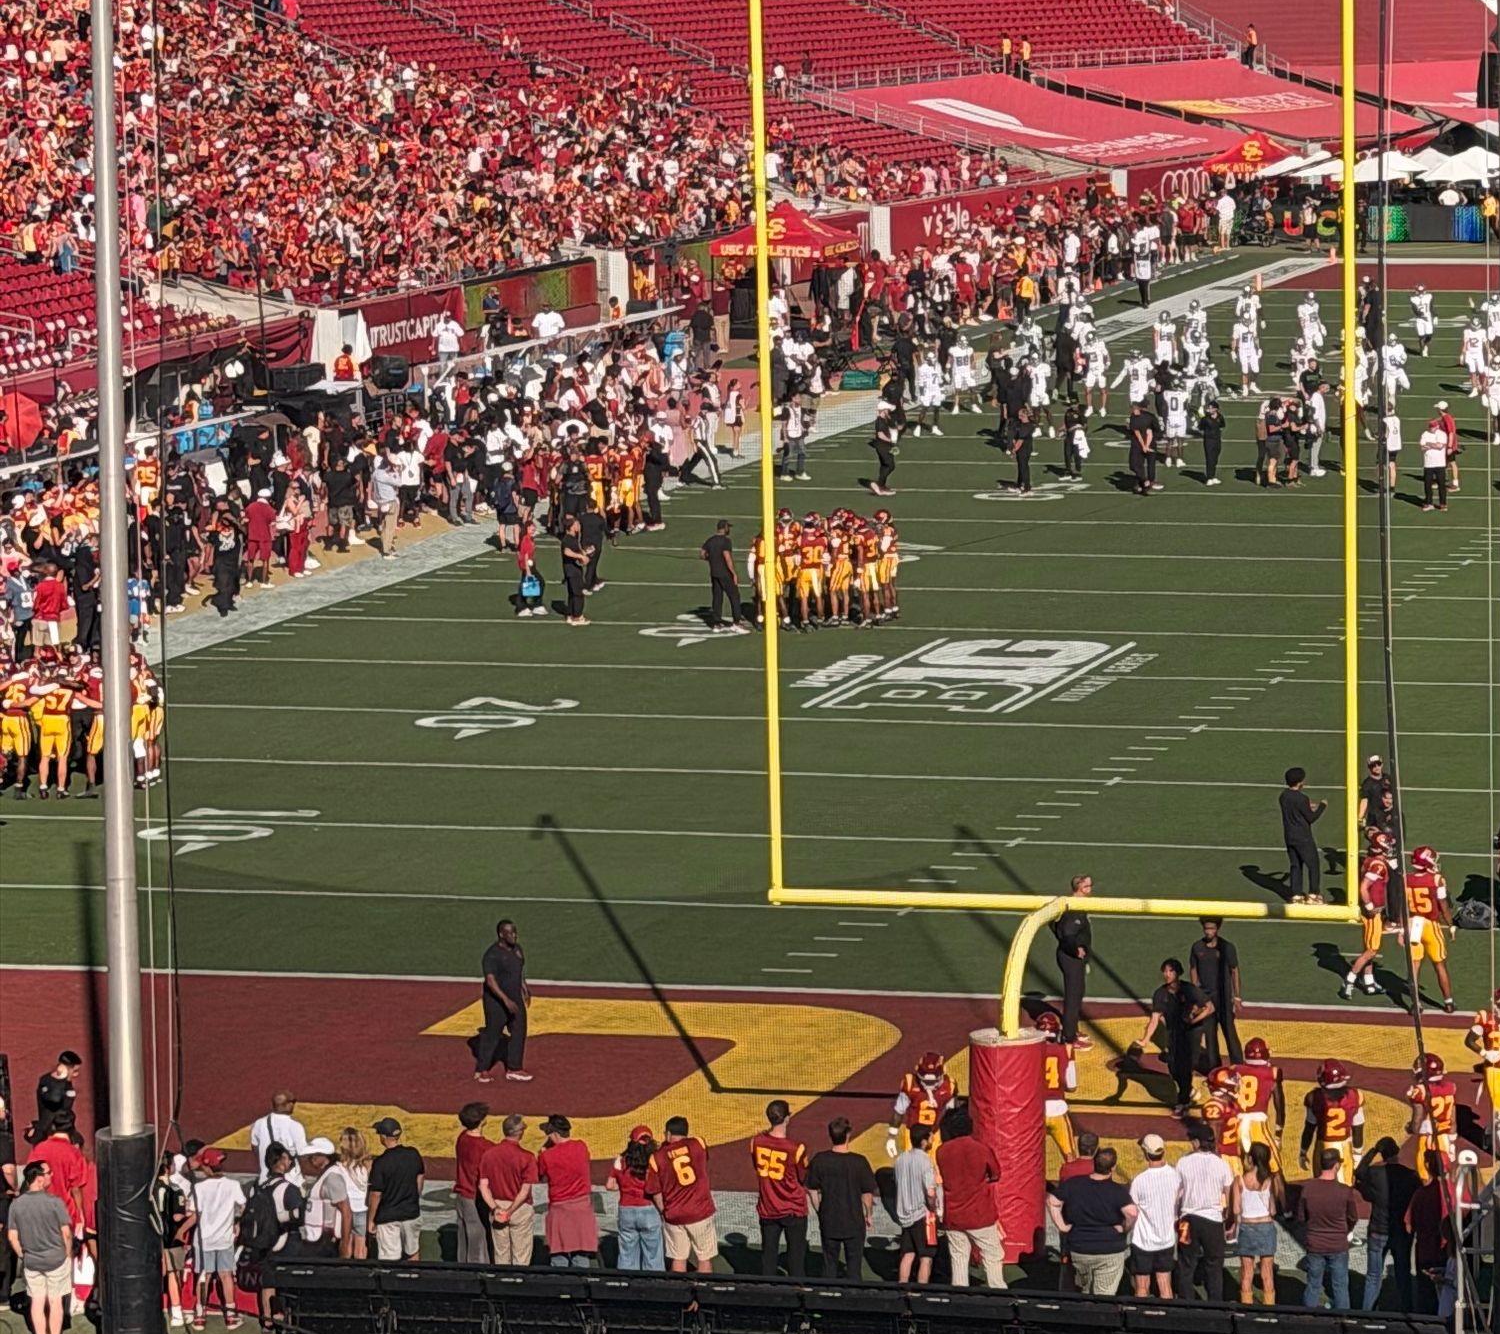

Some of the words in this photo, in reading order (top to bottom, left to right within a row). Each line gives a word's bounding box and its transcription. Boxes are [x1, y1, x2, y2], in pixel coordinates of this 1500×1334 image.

[720, 244, 744, 256] USC
[414, 696, 580, 728] 20
[136, 807, 321, 843] 10
[1326, 1107, 1346, 1137] 2
[673, 1155, 697, 1186] 6
[756, 1146, 788, 1181] 55
